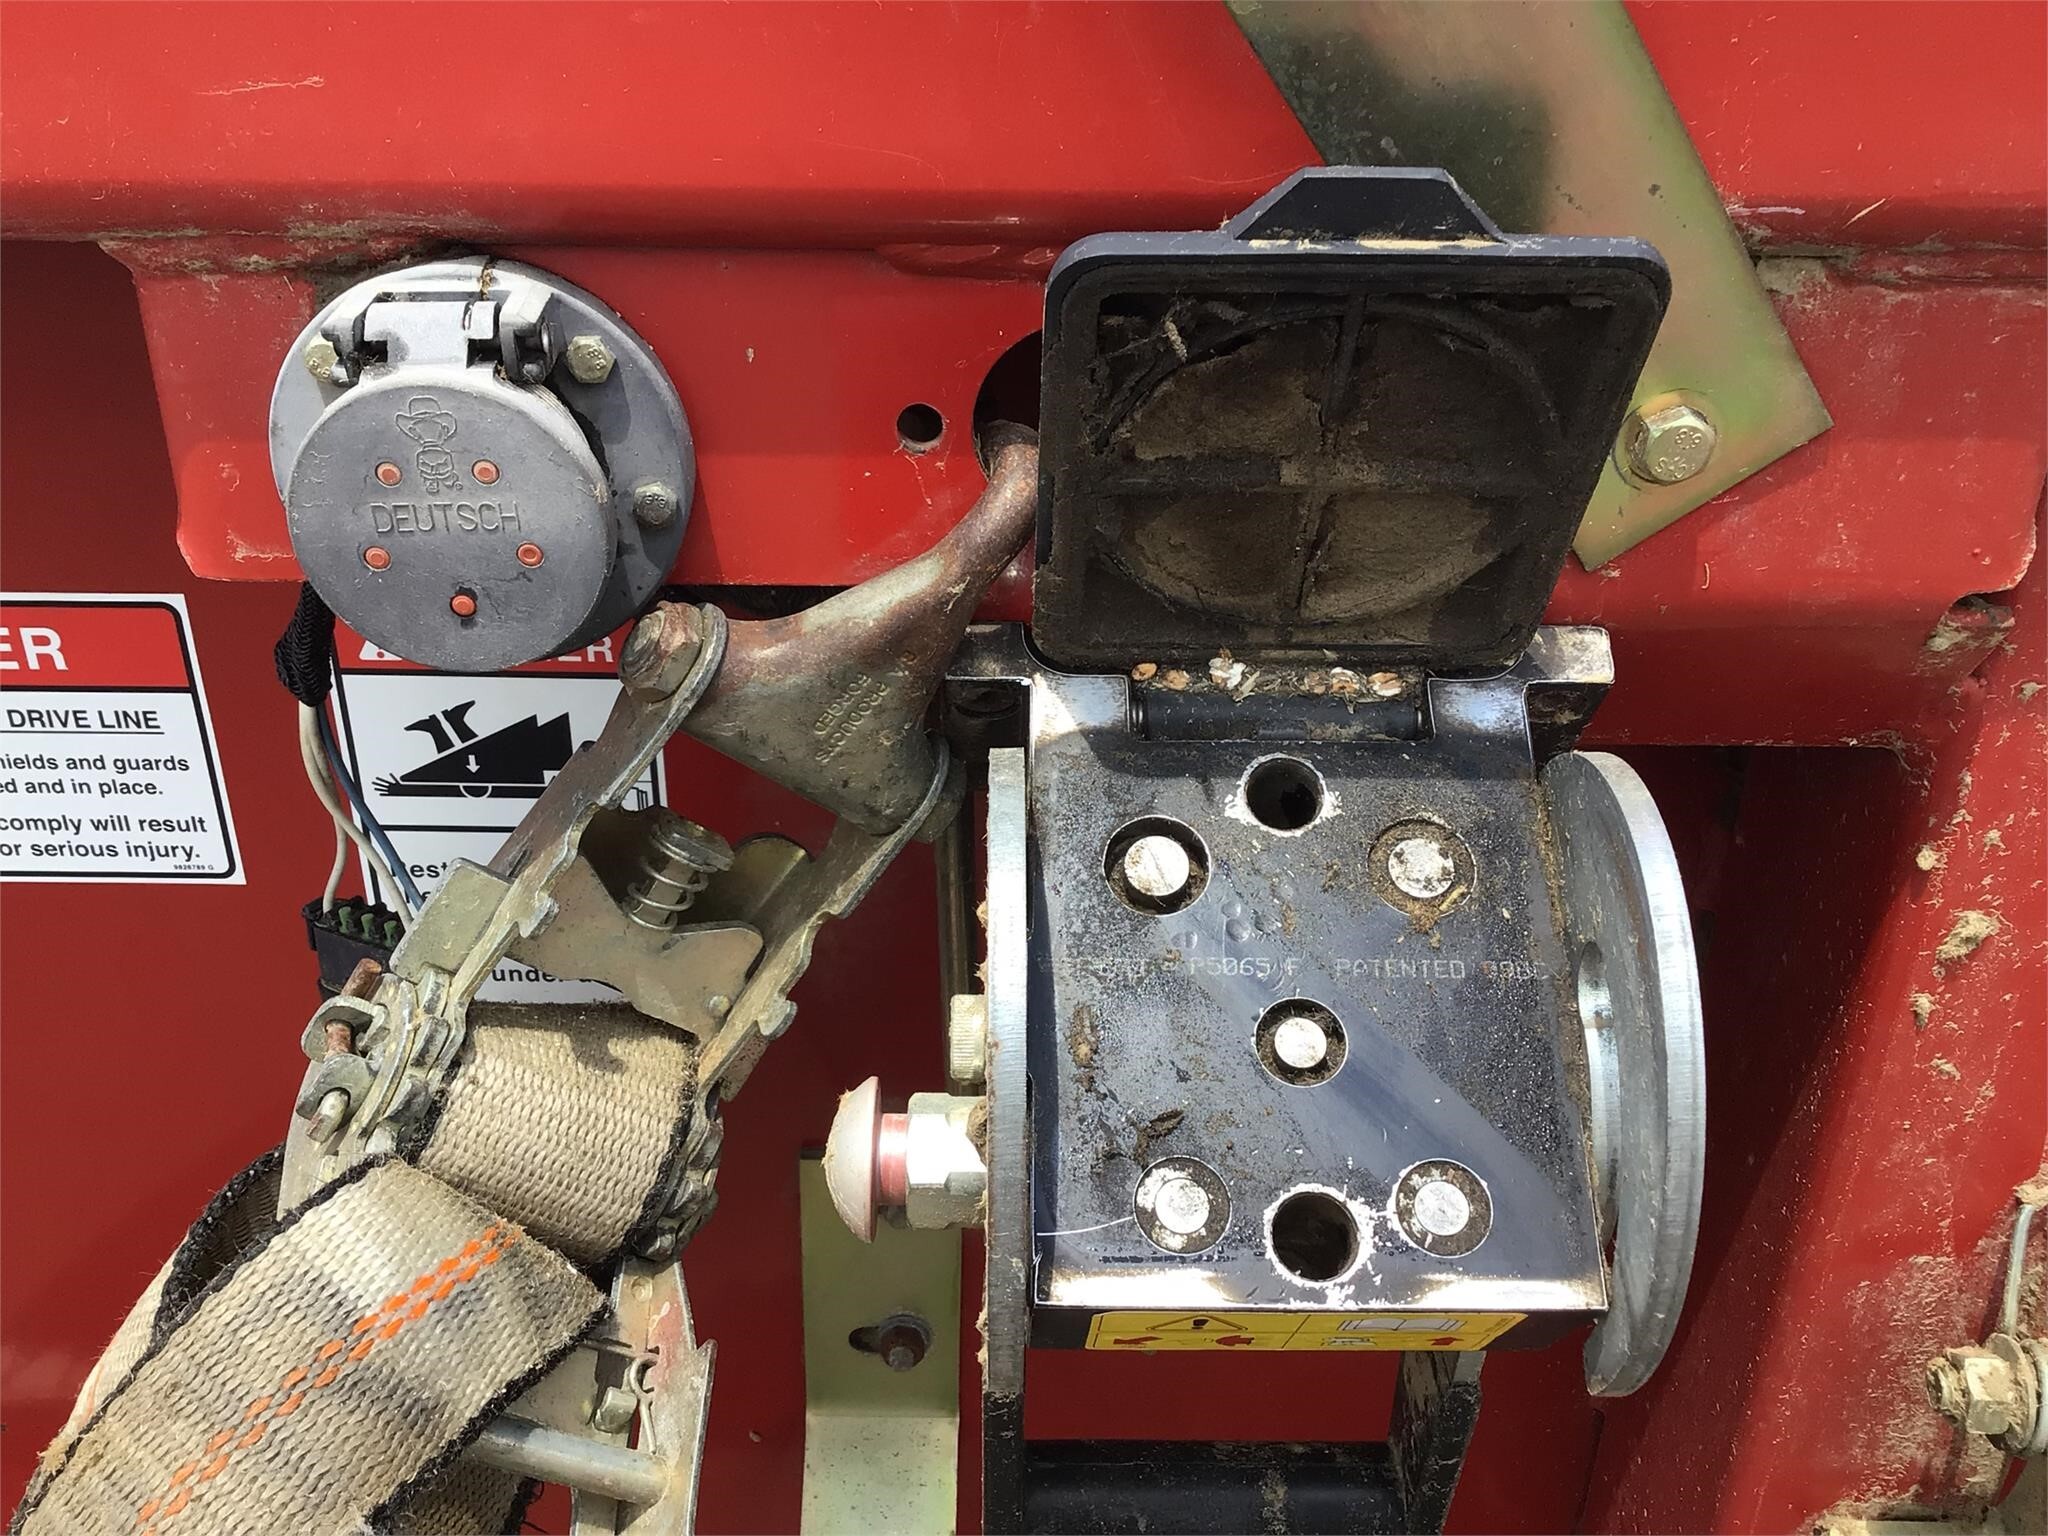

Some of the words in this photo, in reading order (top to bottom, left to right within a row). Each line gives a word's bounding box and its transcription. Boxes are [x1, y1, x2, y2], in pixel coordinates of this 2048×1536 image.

[370, 501, 521, 534] DEUTSCH
[7, 709, 91, 729] DRIVE
[97, 710, 161, 729] LINE
[66, 754, 106, 771] and
[113, 755, 190, 774] guards
[24, 778, 65, 794] and
[71, 779, 91, 795] in
[100, 779, 164, 798] place.
[0, 814, 82, 836] comply
[90, 815, 131, 832] will
[138, 816, 208, 833] result
[30, 841, 119, 858] serious
[125, 841, 201, 862] injury.
[1335, 957, 1466, 980] PATENTED
